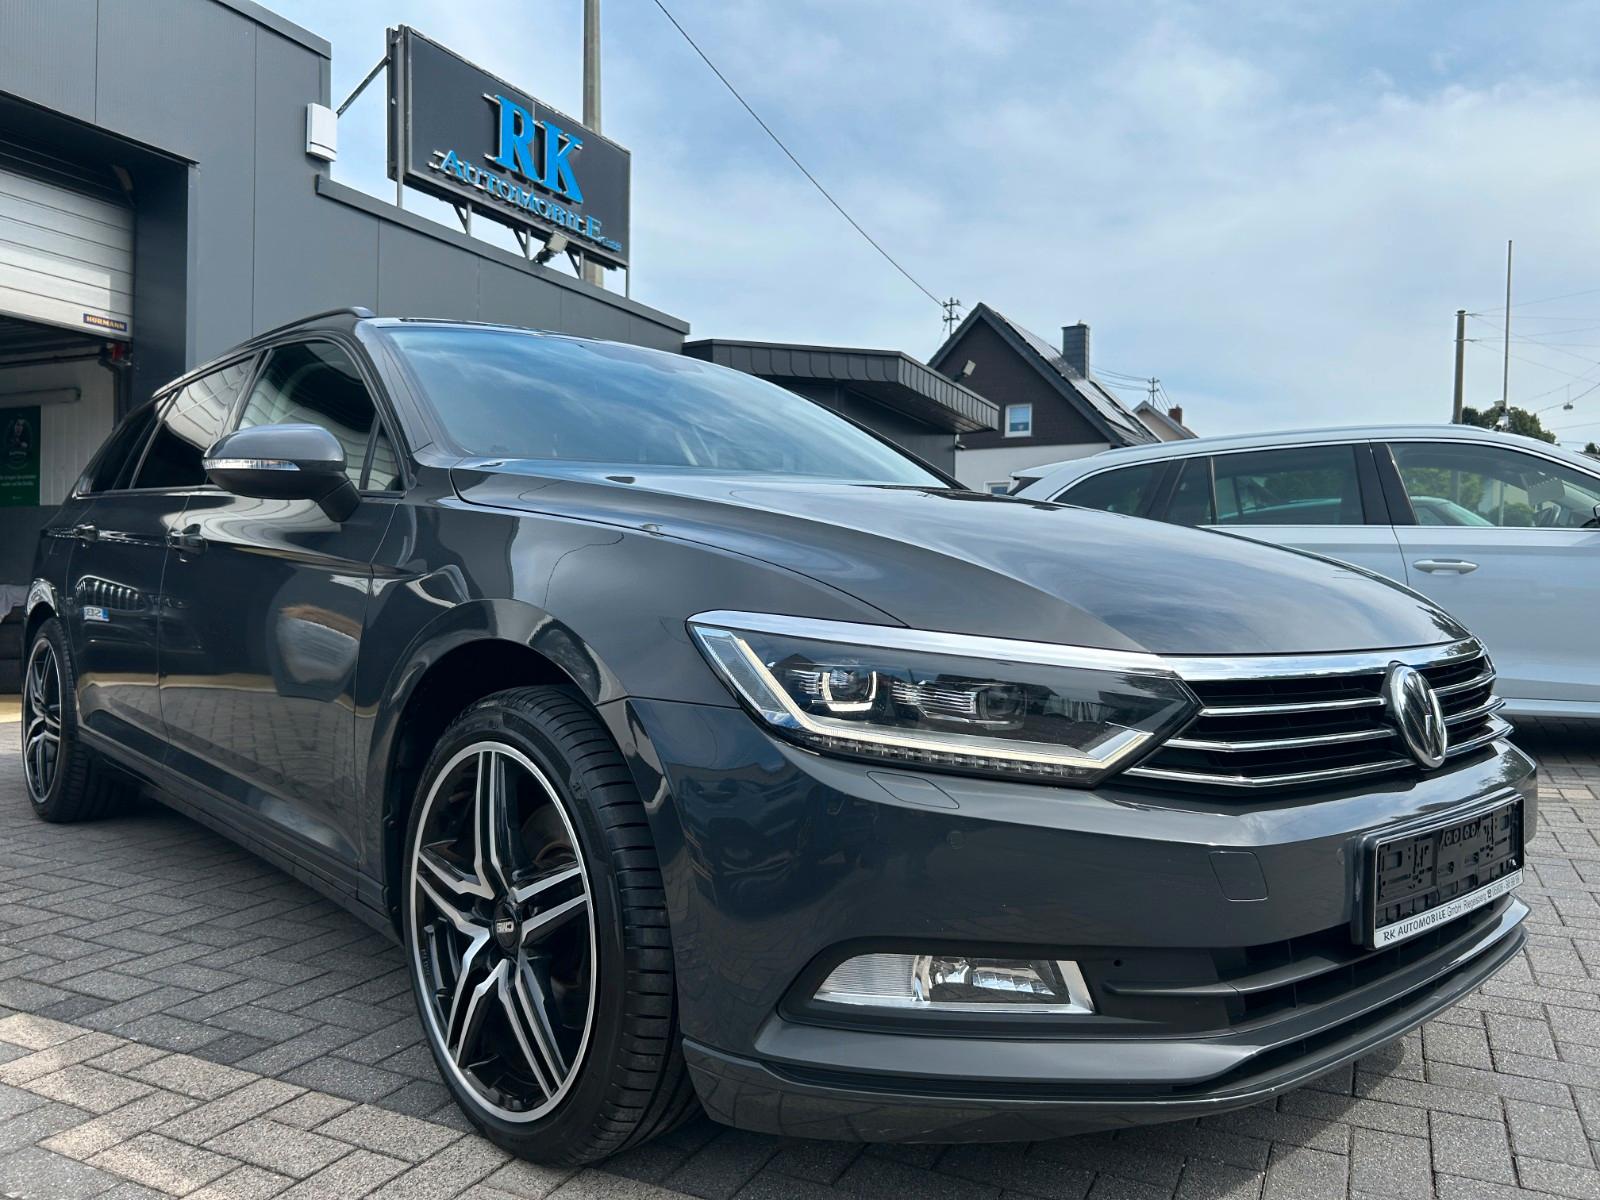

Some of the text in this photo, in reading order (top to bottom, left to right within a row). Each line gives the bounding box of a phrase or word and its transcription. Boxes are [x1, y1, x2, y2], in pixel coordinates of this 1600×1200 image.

[484, 94, 583, 204] RK
[432, 150, 602, 243] AUTOMOBILE
[1383, 929, 1396, 942] RK
[1397, 909, 1446, 937] AUTOMOBILE
